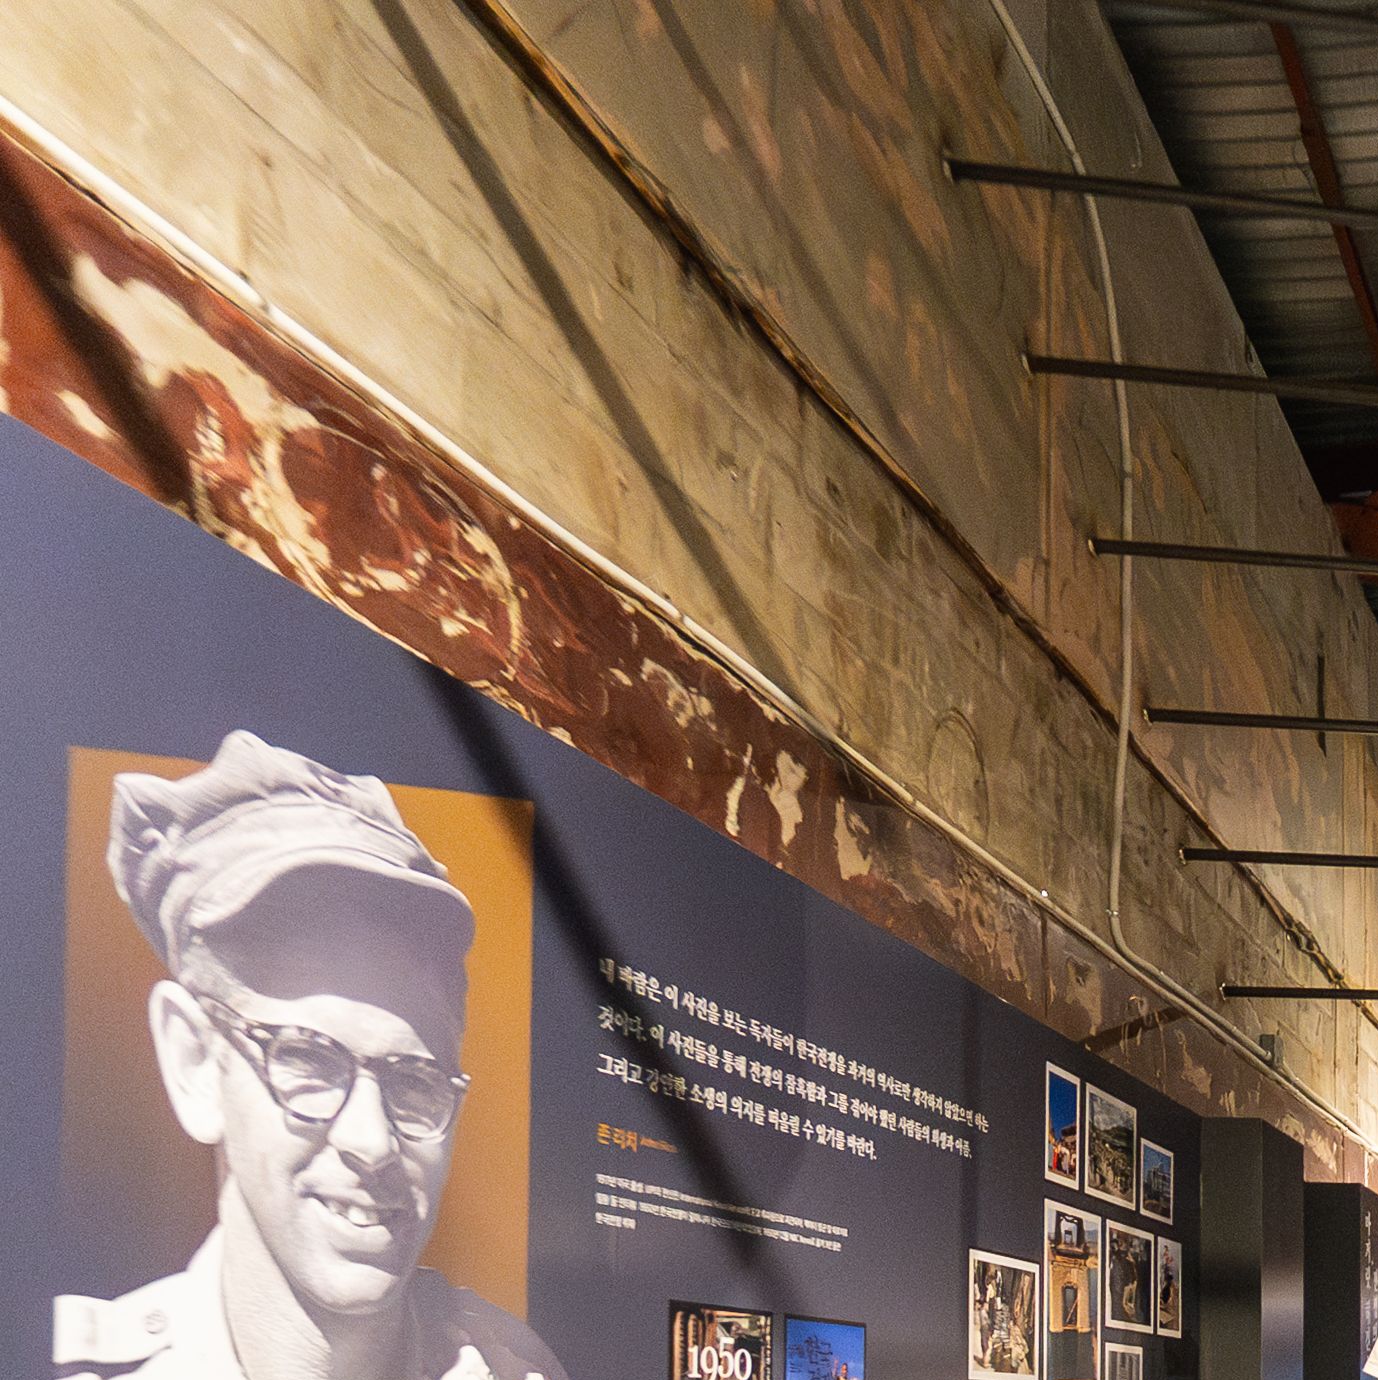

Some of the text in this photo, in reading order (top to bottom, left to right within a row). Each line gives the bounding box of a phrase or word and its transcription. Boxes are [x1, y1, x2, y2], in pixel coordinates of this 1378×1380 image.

[596, 1053, 644, 1084] 그리고
[690, 1083, 727, 1114] 소생의
[730, 1096, 765, 1126] 의지를
[802, 1119, 814, 1140] 수
[815, 1123, 846, 1151] 있기를
[847, 1134, 877, 1161] 바란다.
[598, 1005, 647, 1041] 것이다.
[650, 1024, 664, 1049] 이
[667, 1030, 720, 1069] 사진들을
[722, 1050, 747, 1079] 통해
[749, 1060, 783, 1091] 전쟁의
[785, 1073, 827, 1106] 참혹함과
[828, 1091, 849, 1115] 그를
[879, 1109, 897, 1132] 했던
[898, 1116, 930, 1144] 사람들의
[931, 1128, 954, 1152] 희생과
[664, 984, 679, 1010] 이
[682, 991, 721, 1026] 사진을
[722, 1008, 748, 1036] 보는
[749, 1018, 794, 1055] 독자들이
[796, 1038, 846, 1076] 한국전쟁을
[848, 1060, 876, 1088] 과거의
[877, 1072, 912, 1101] 역사로만
[912, 1087, 943, 1115] 생각하지
[974, 1113, 989, 1134] 하는
